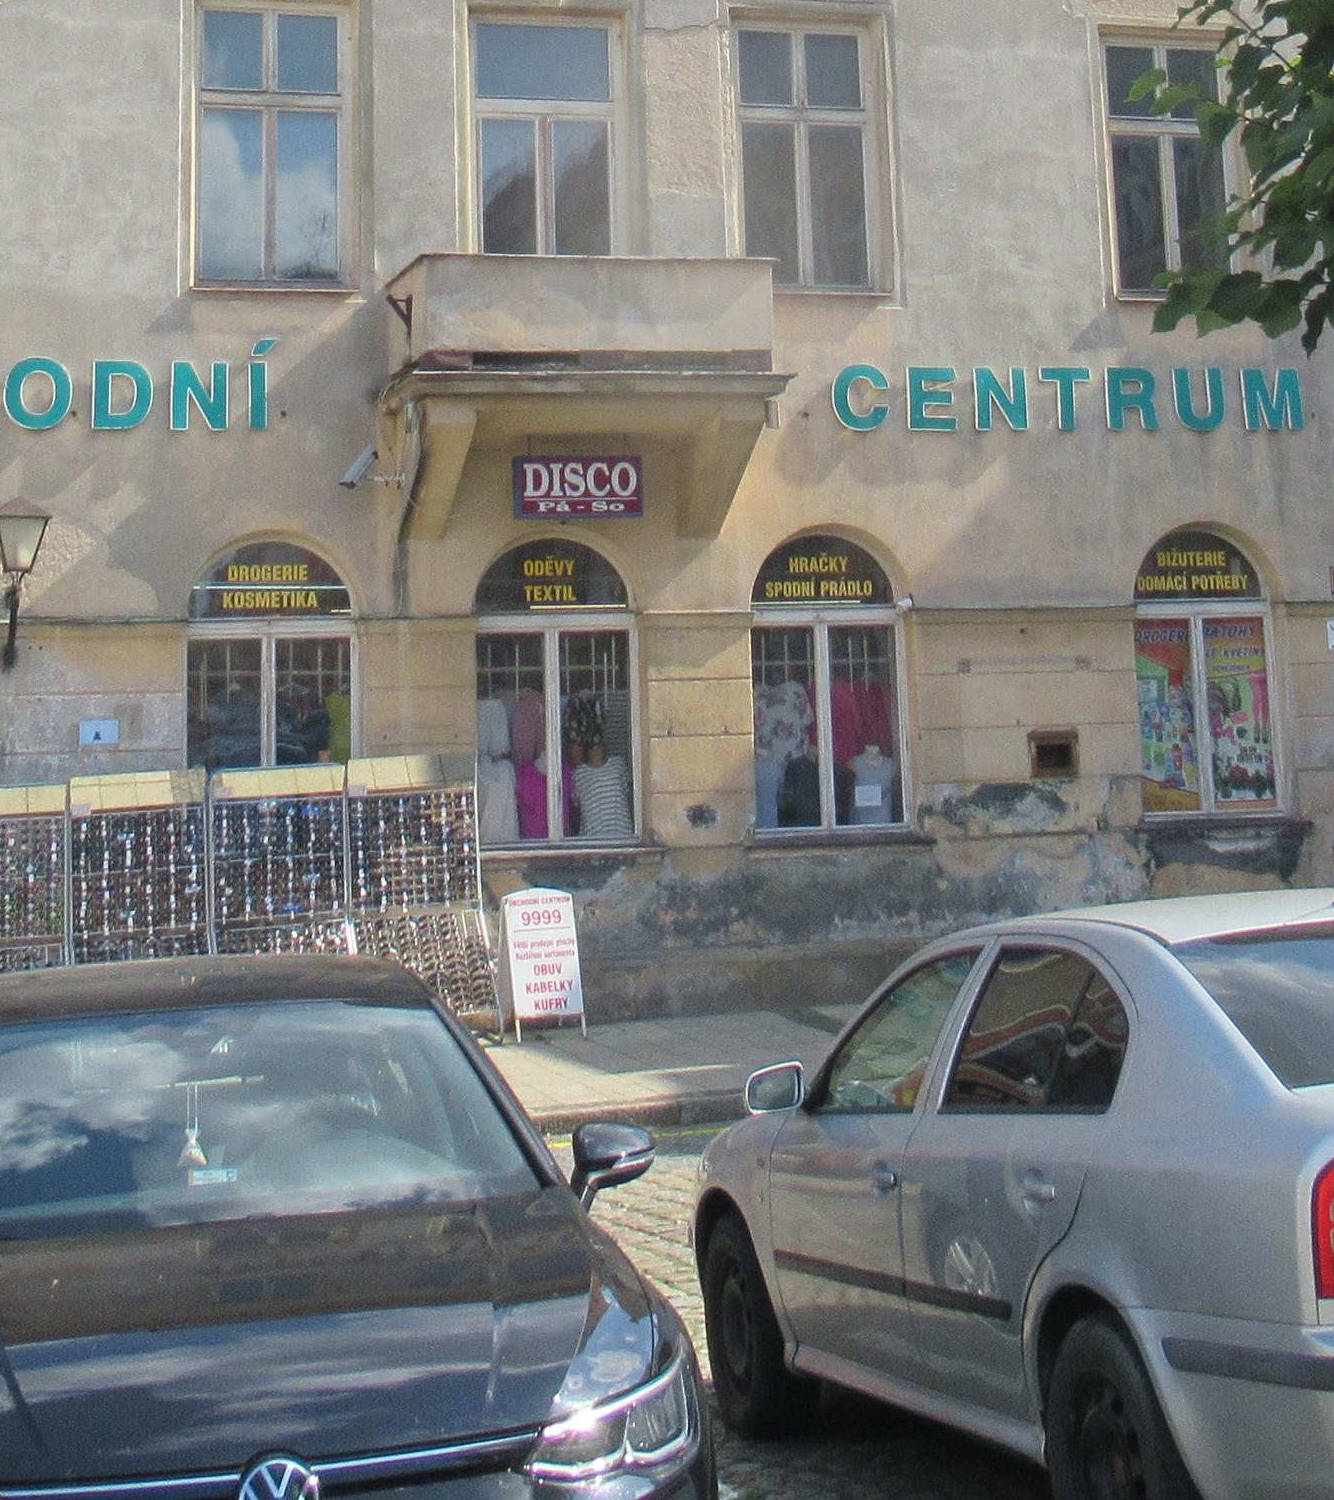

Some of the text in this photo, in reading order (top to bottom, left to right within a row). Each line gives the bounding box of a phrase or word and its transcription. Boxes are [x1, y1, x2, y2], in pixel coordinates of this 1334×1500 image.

[831, 362, 1307, 432] CENTRUM
[522, 461, 637, 498] DISCO
[538, 501, 571, 512] Pá
[591, 501, 625, 512] So
[523, 555, 575, 577] ODĚVY
[789, 552, 848, 573] HRAČKY
[1157, 547, 1227, 567] BIŽUTERIE
[227, 564, 309, 582] DROGERIE
[1136, 570, 1249, 592] DOMÁCÍ POTŘEBY
[523, 584, 577, 602] TEXTIL
[765, 575, 873, 598] SPODNÍ PRÁDLO
[222, 590, 318, 609] KOSMETIKA
[521, 909, 562, 926] 9999
[533, 963, 563, 976] OBUV
[525, 979, 574, 994] KABELKY
[533, 997, 569, 1011] KUFRY
